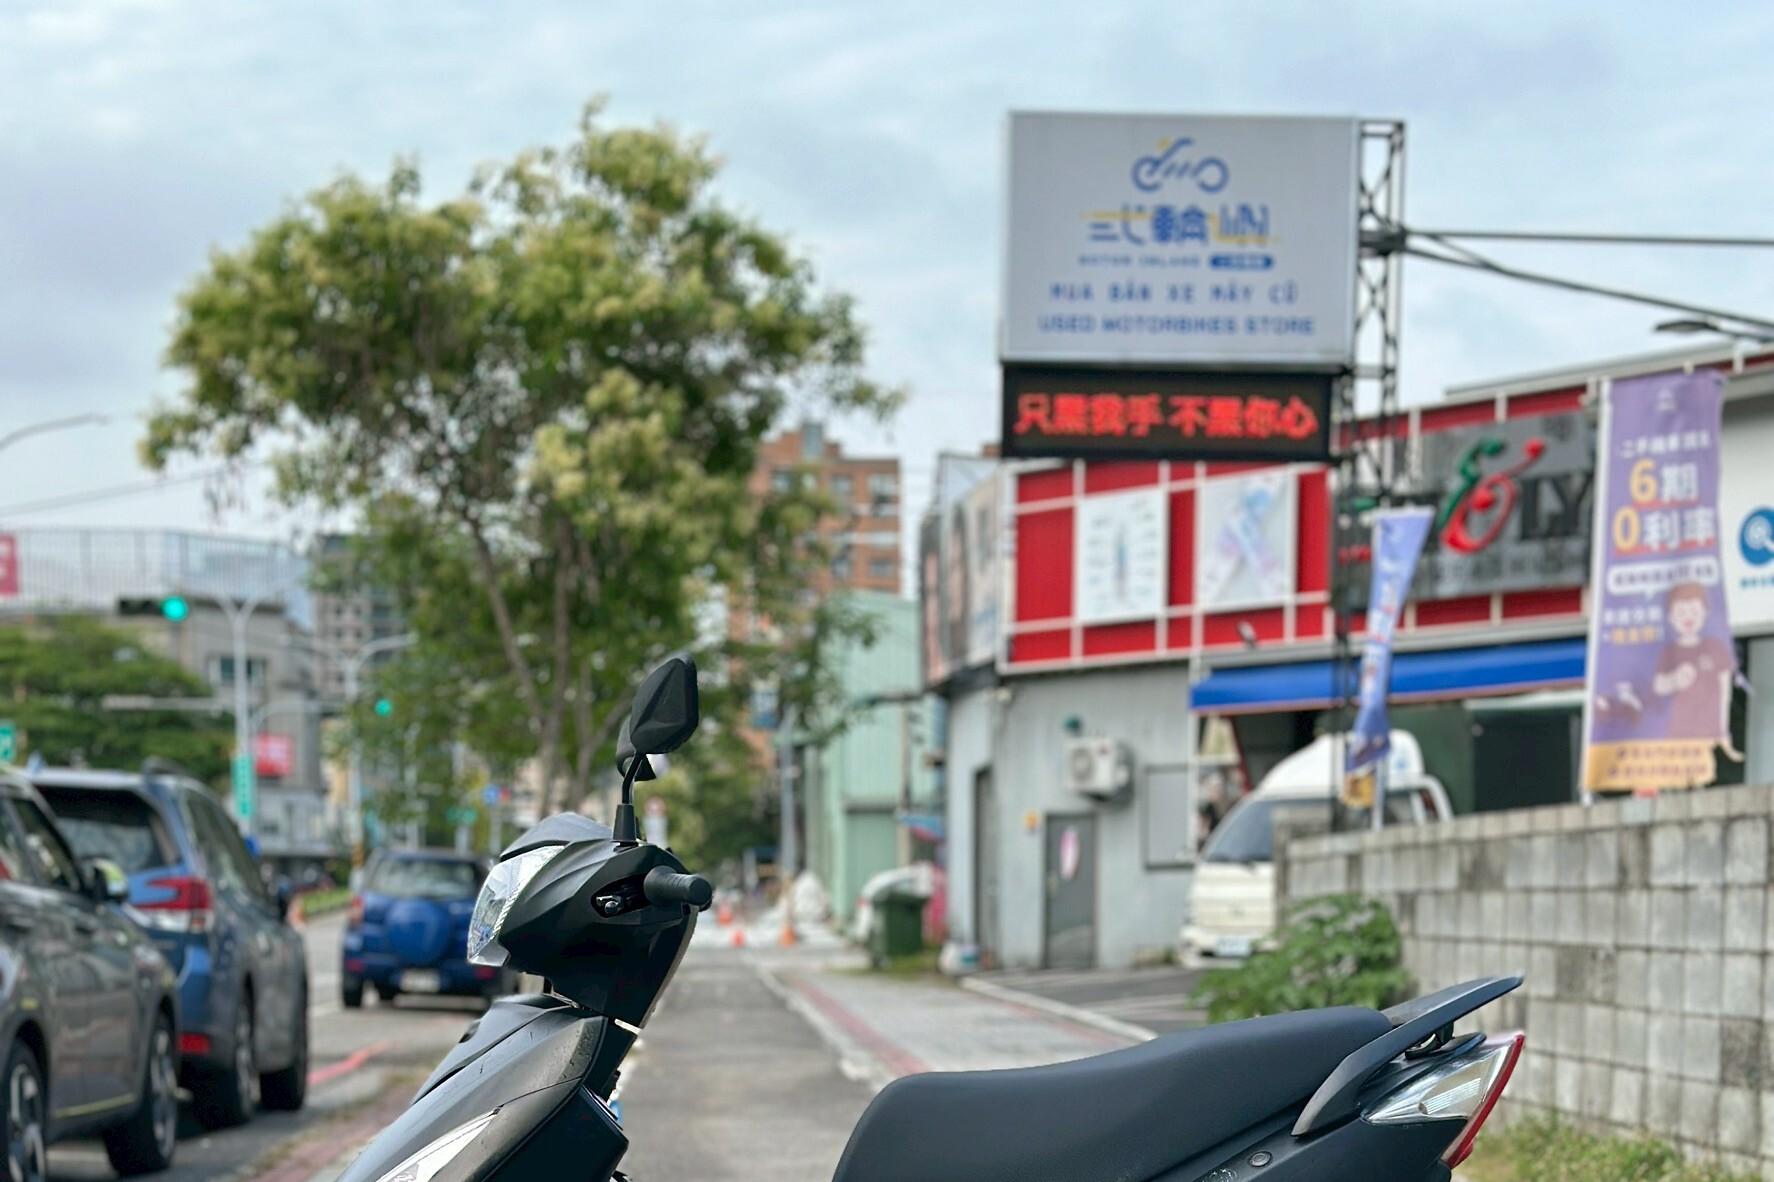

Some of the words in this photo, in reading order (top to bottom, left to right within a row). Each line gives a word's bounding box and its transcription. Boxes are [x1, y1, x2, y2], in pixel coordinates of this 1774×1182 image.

[1037, 315, 1095, 335] USED
[1102, 315, 1238, 336] MOTORBIKES
[1245, 316, 1316, 337] STORE
[1612, 505, 1717, 552] 0利率
